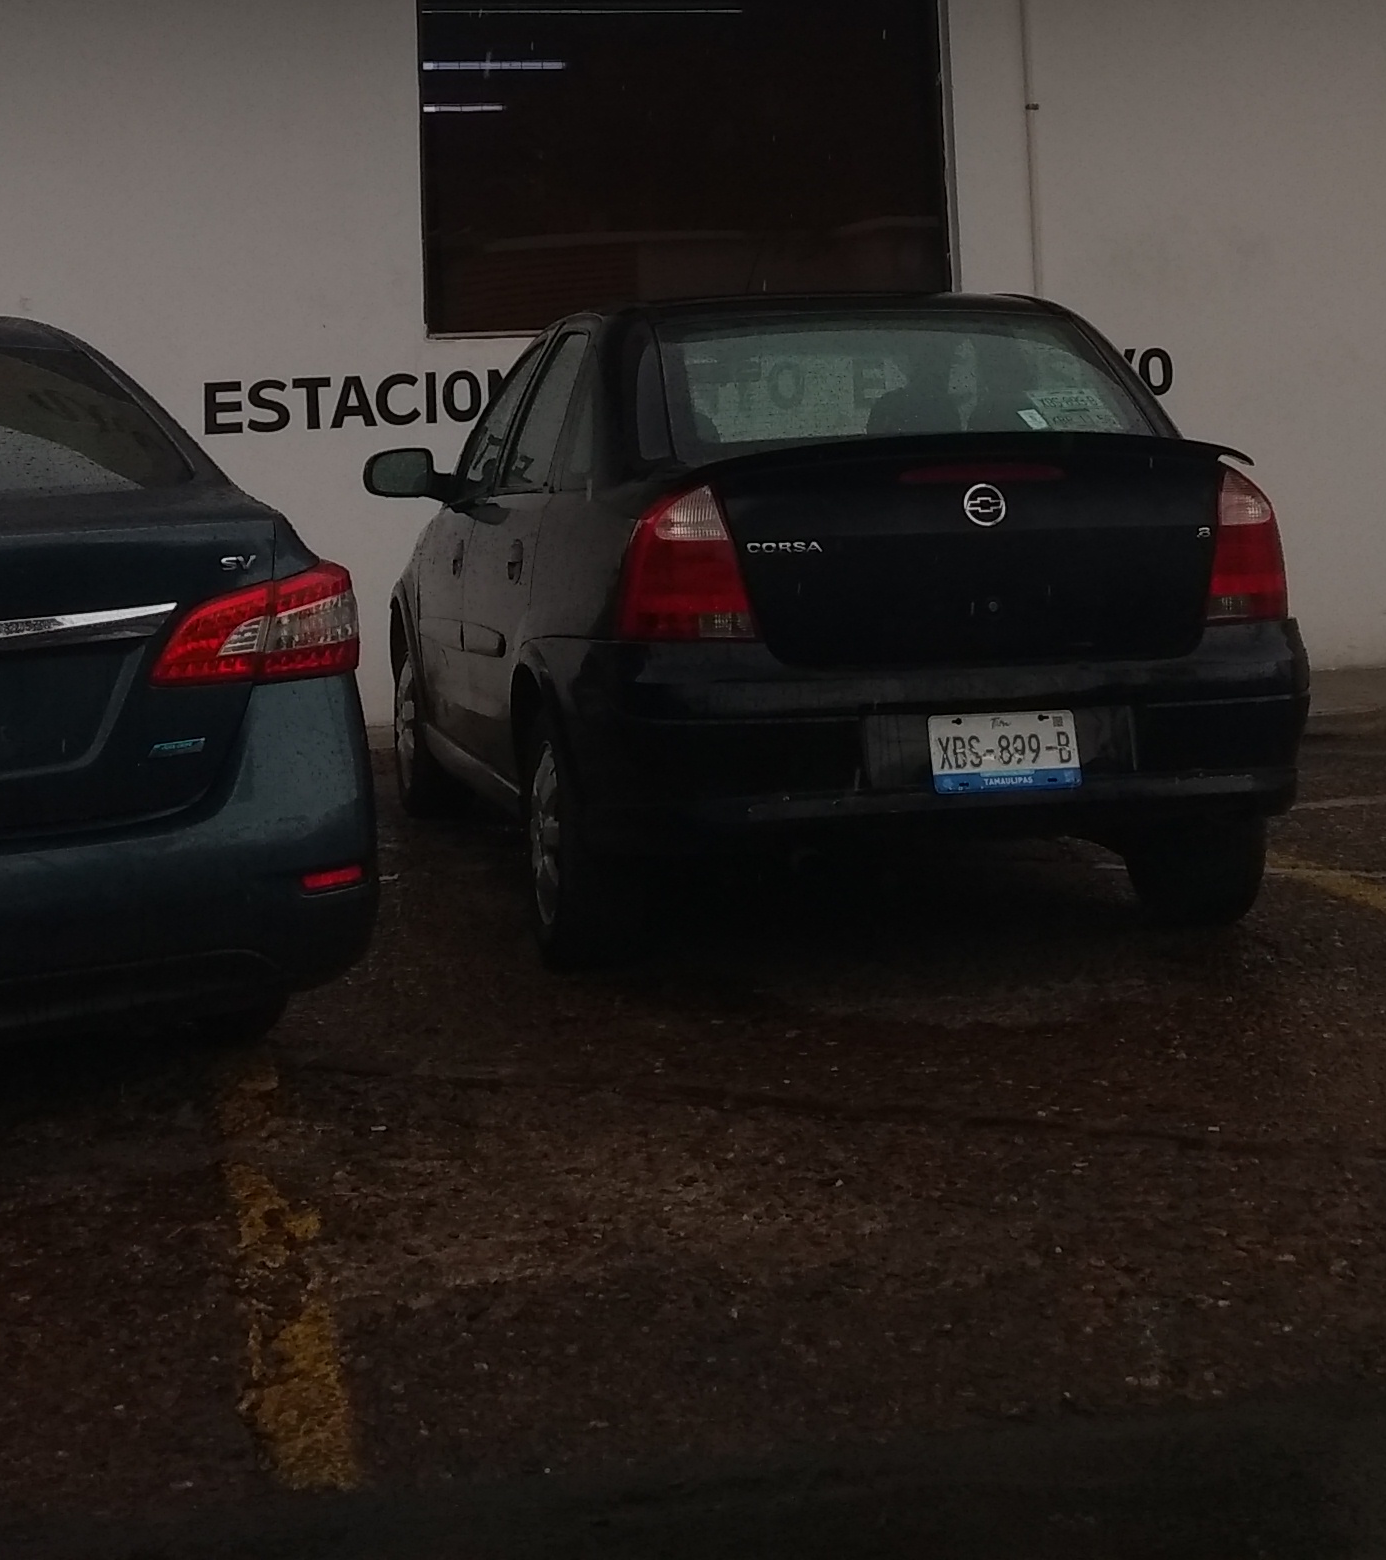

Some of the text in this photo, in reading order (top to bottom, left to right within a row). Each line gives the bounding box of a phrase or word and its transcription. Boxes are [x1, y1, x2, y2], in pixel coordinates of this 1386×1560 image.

[746, 541, 824, 554] CORSA
[220, 554, 257, 571] SV
[937, 731, 1072, 770] XBS-899-B
